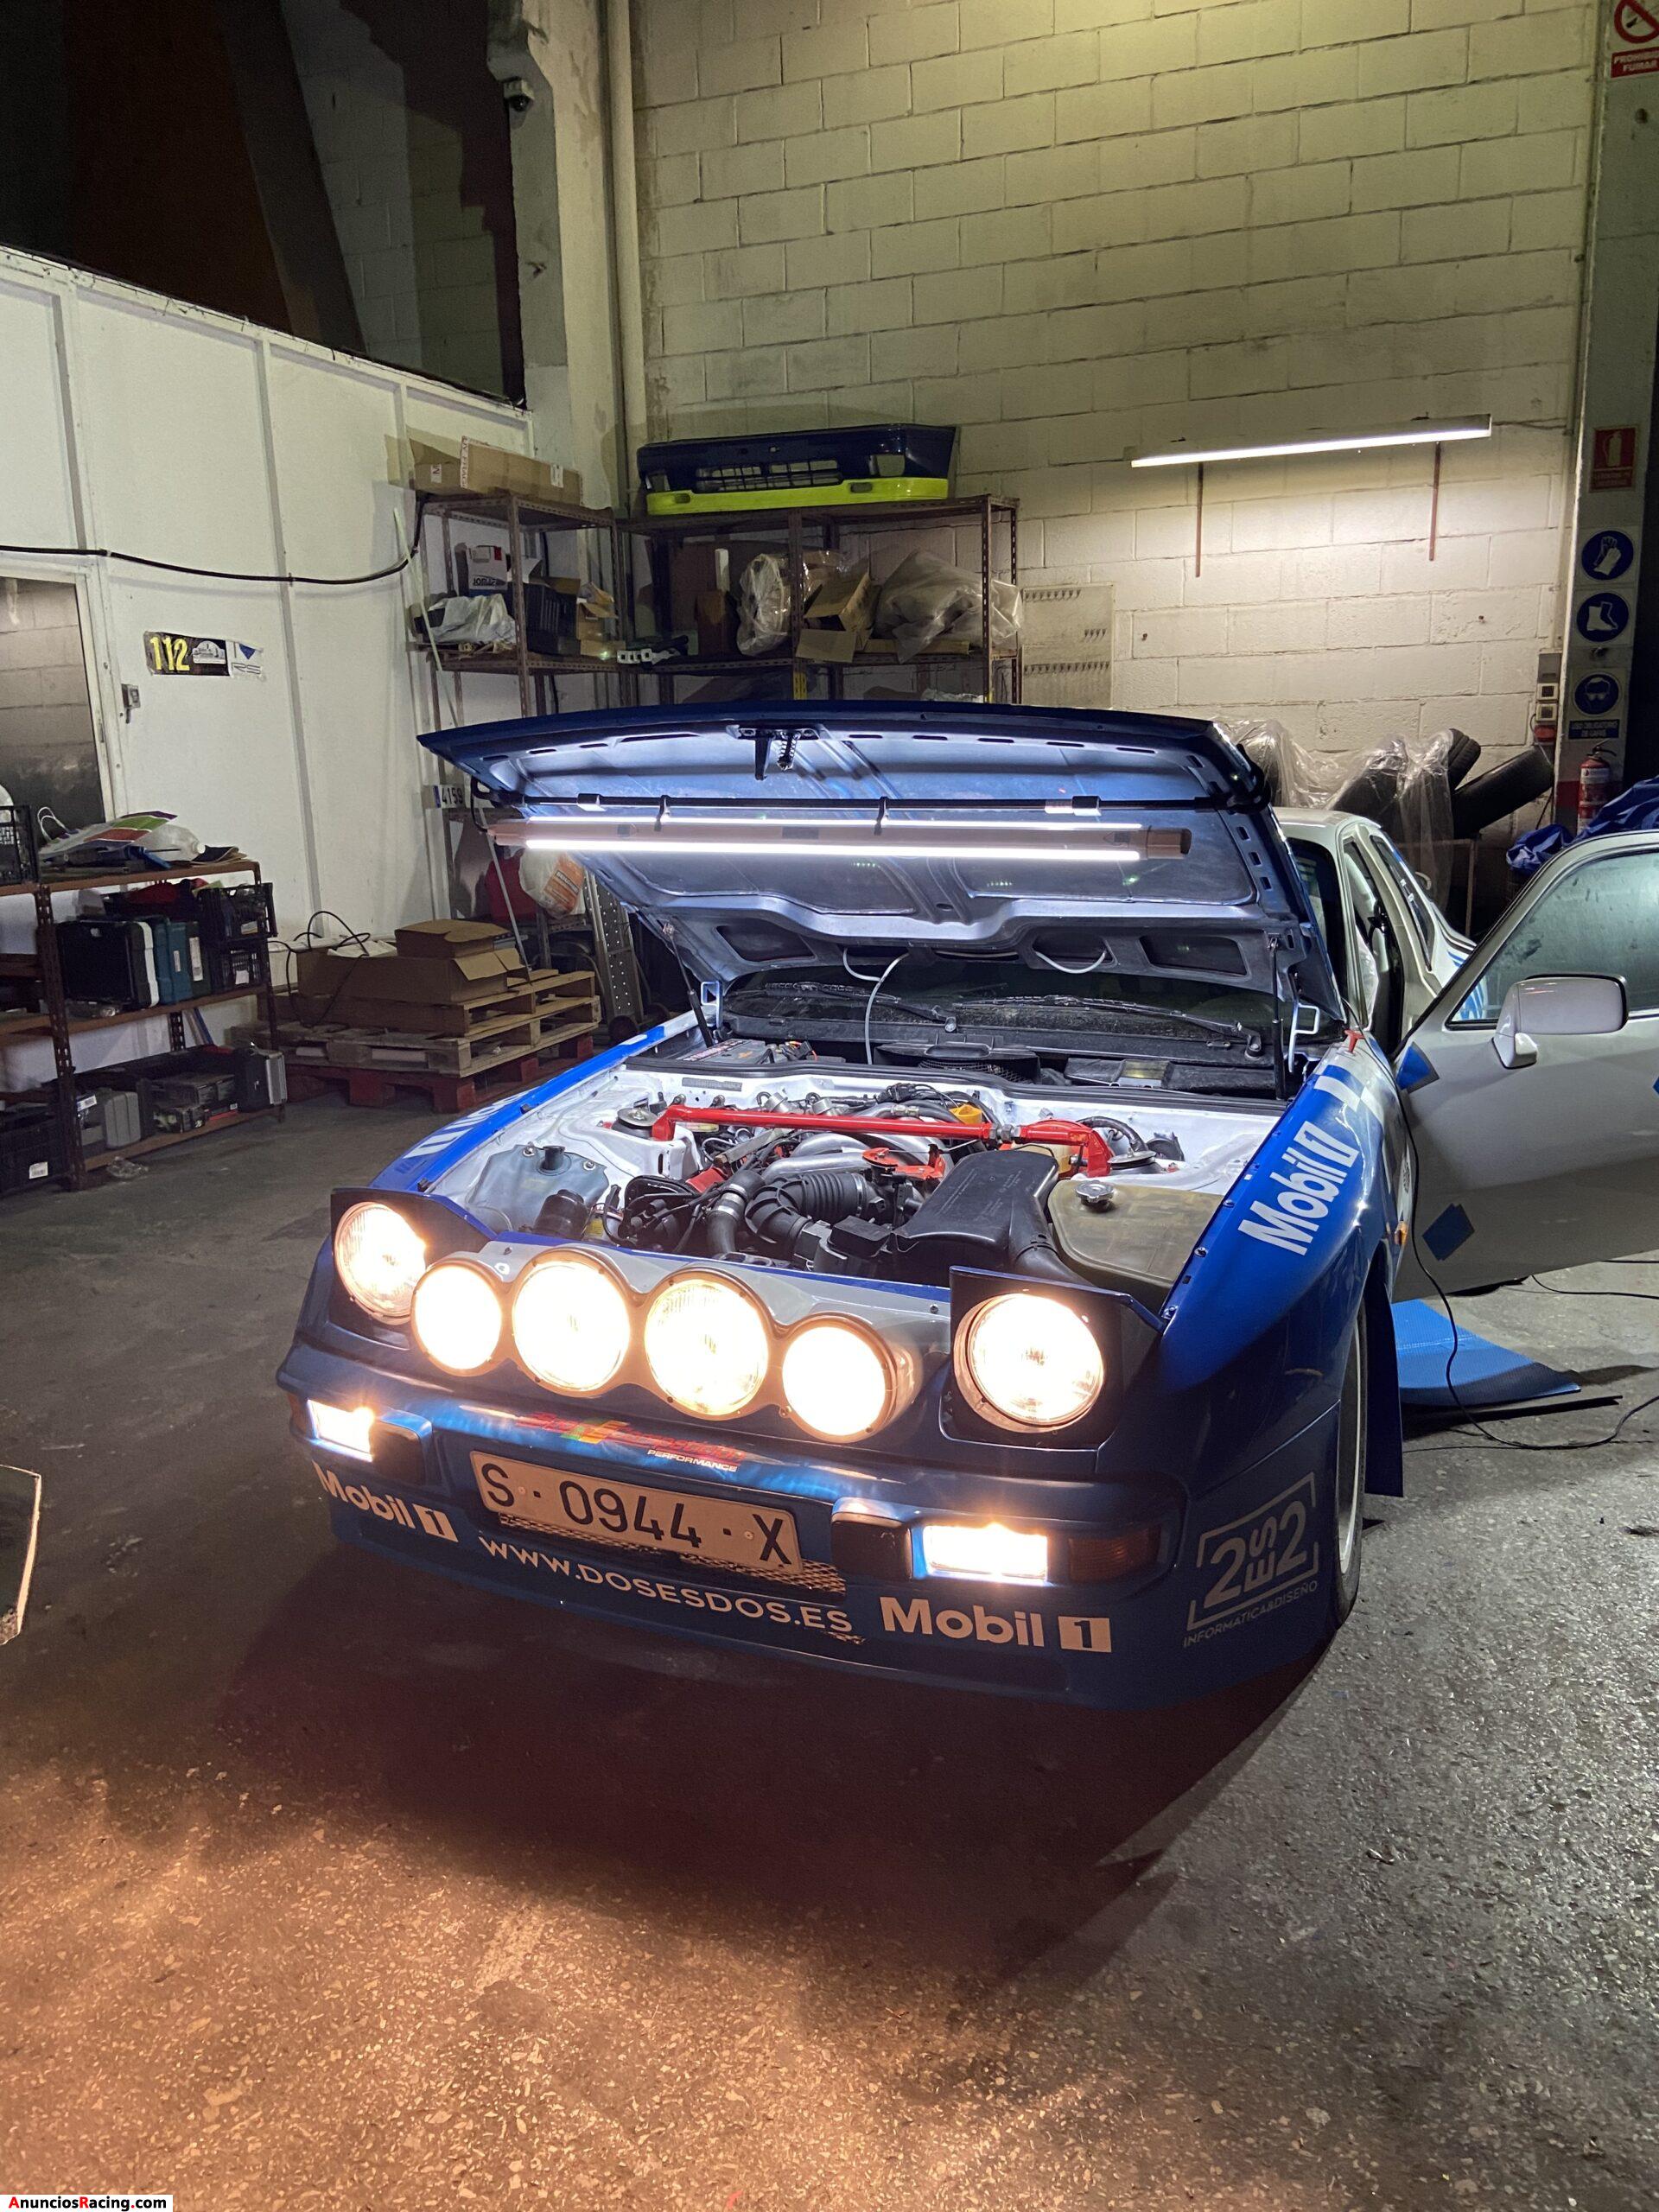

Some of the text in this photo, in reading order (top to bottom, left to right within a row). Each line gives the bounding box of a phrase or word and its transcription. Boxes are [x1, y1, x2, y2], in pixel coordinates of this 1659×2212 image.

[149, 636, 190, 671] 112
[1238, 1147, 1347, 1256] Mobil
[312, 1459, 416, 1529] Mobil
[647, 1449, 738, 1473] PERFORMANCE
[481, 1463, 791, 1565] S 0944 X
[478, 1535, 853, 1632] WWW.DOSESDOS.ES
[880, 1596, 1045, 1648] Mobil
